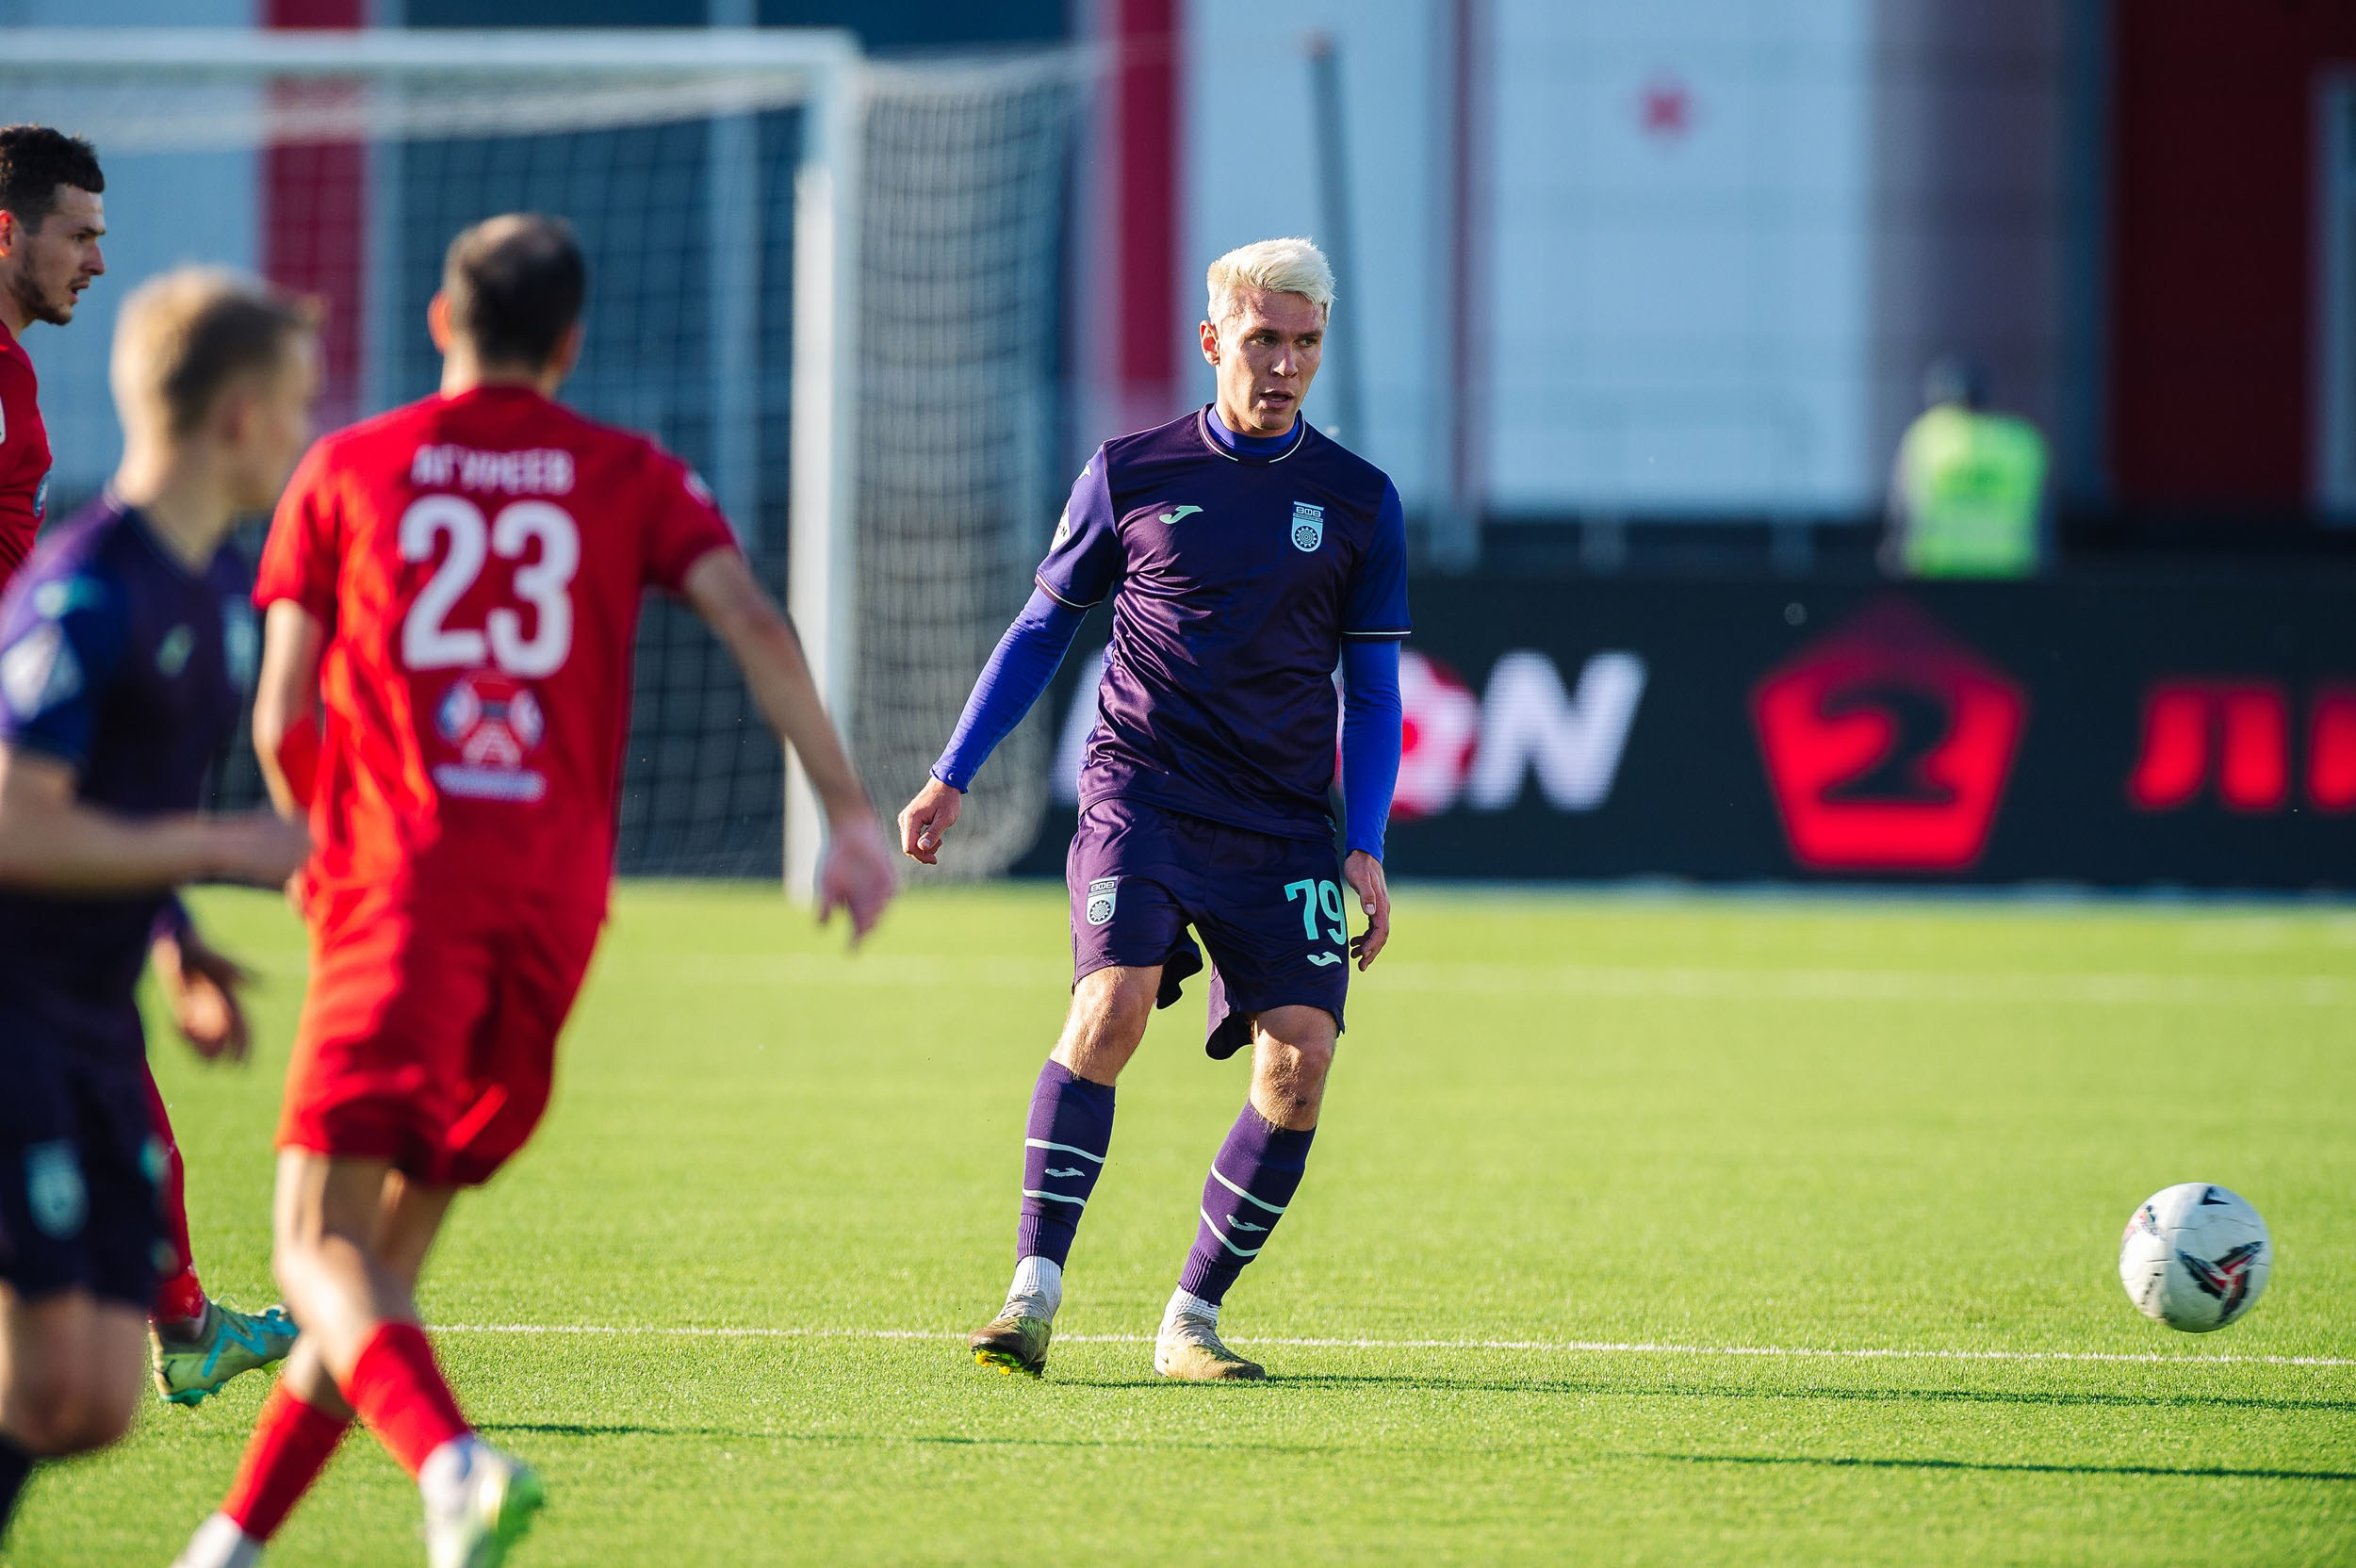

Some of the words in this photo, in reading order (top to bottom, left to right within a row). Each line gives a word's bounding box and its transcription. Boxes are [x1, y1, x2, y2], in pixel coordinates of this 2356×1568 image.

[400, 495, 580, 678] 23
[1817, 680, 1958, 807] 2
[1284, 878, 1347, 945] 79
